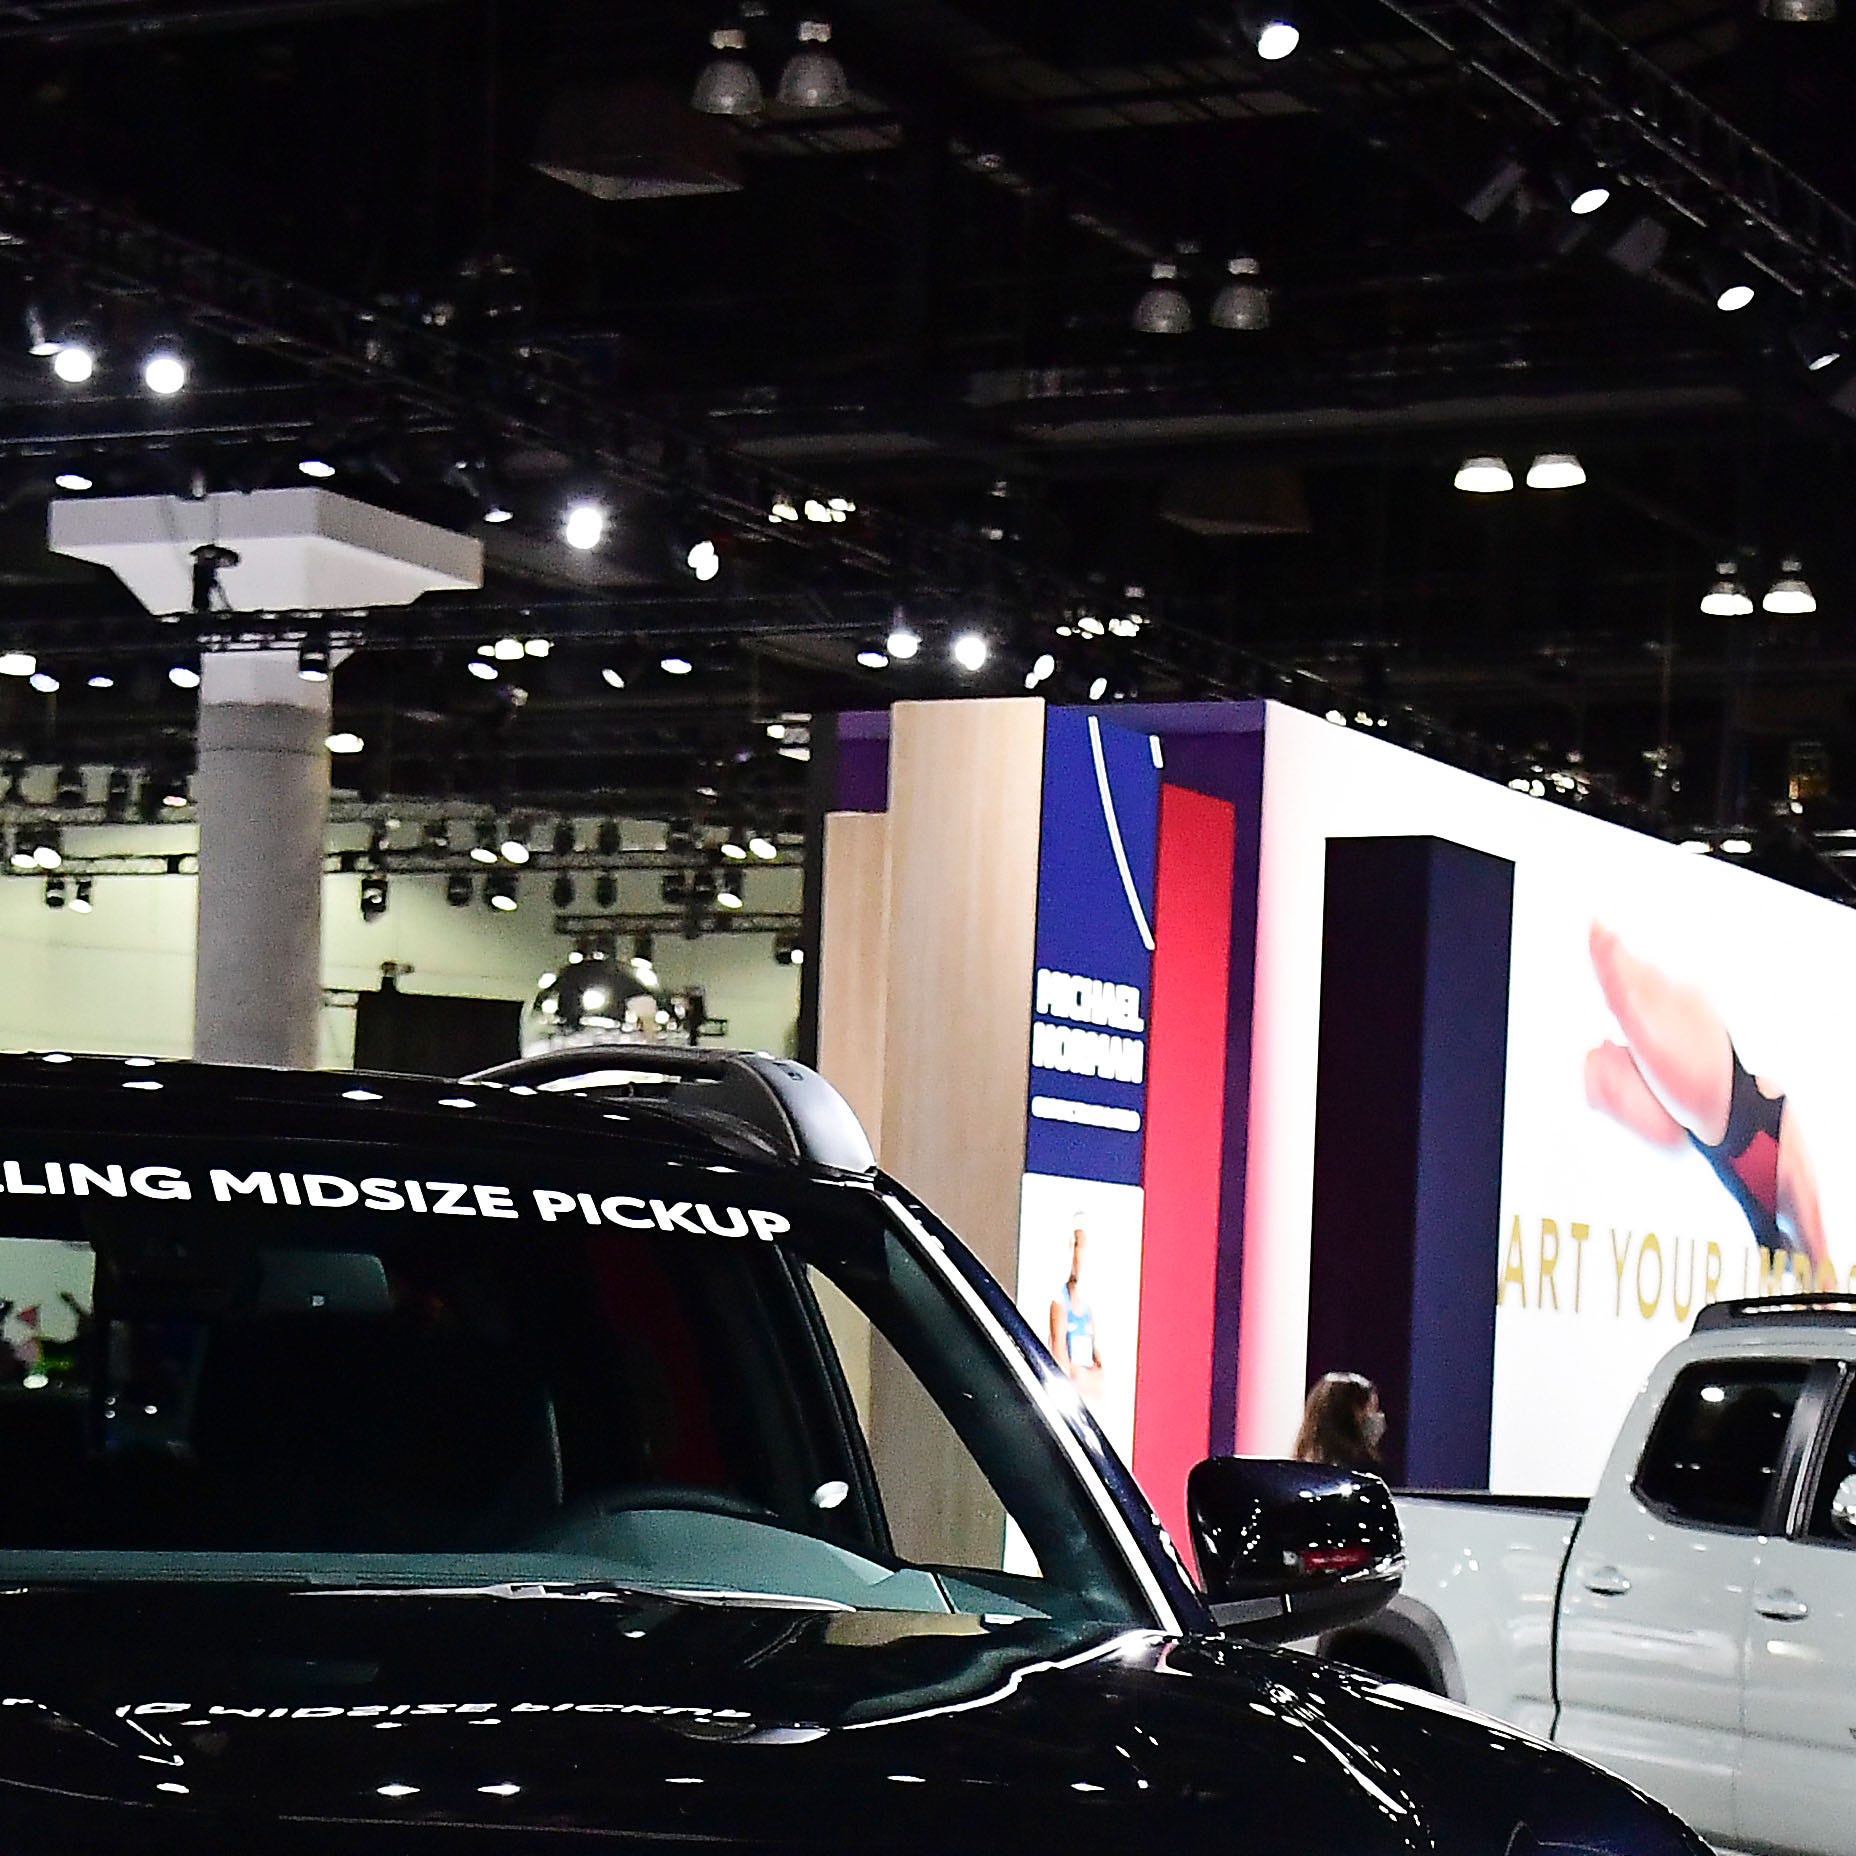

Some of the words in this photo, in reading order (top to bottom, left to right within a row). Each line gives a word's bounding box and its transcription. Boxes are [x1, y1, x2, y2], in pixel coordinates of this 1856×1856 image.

[1036, 968, 1144, 1033] MICHAEL
[1032, 1020, 1144, 1084] NORMAN
[209, 1168, 519, 1219] MIDSIZE
[532, 1188, 792, 1241] PICKUP
[1610, 1228, 1723, 1323] YOUR
